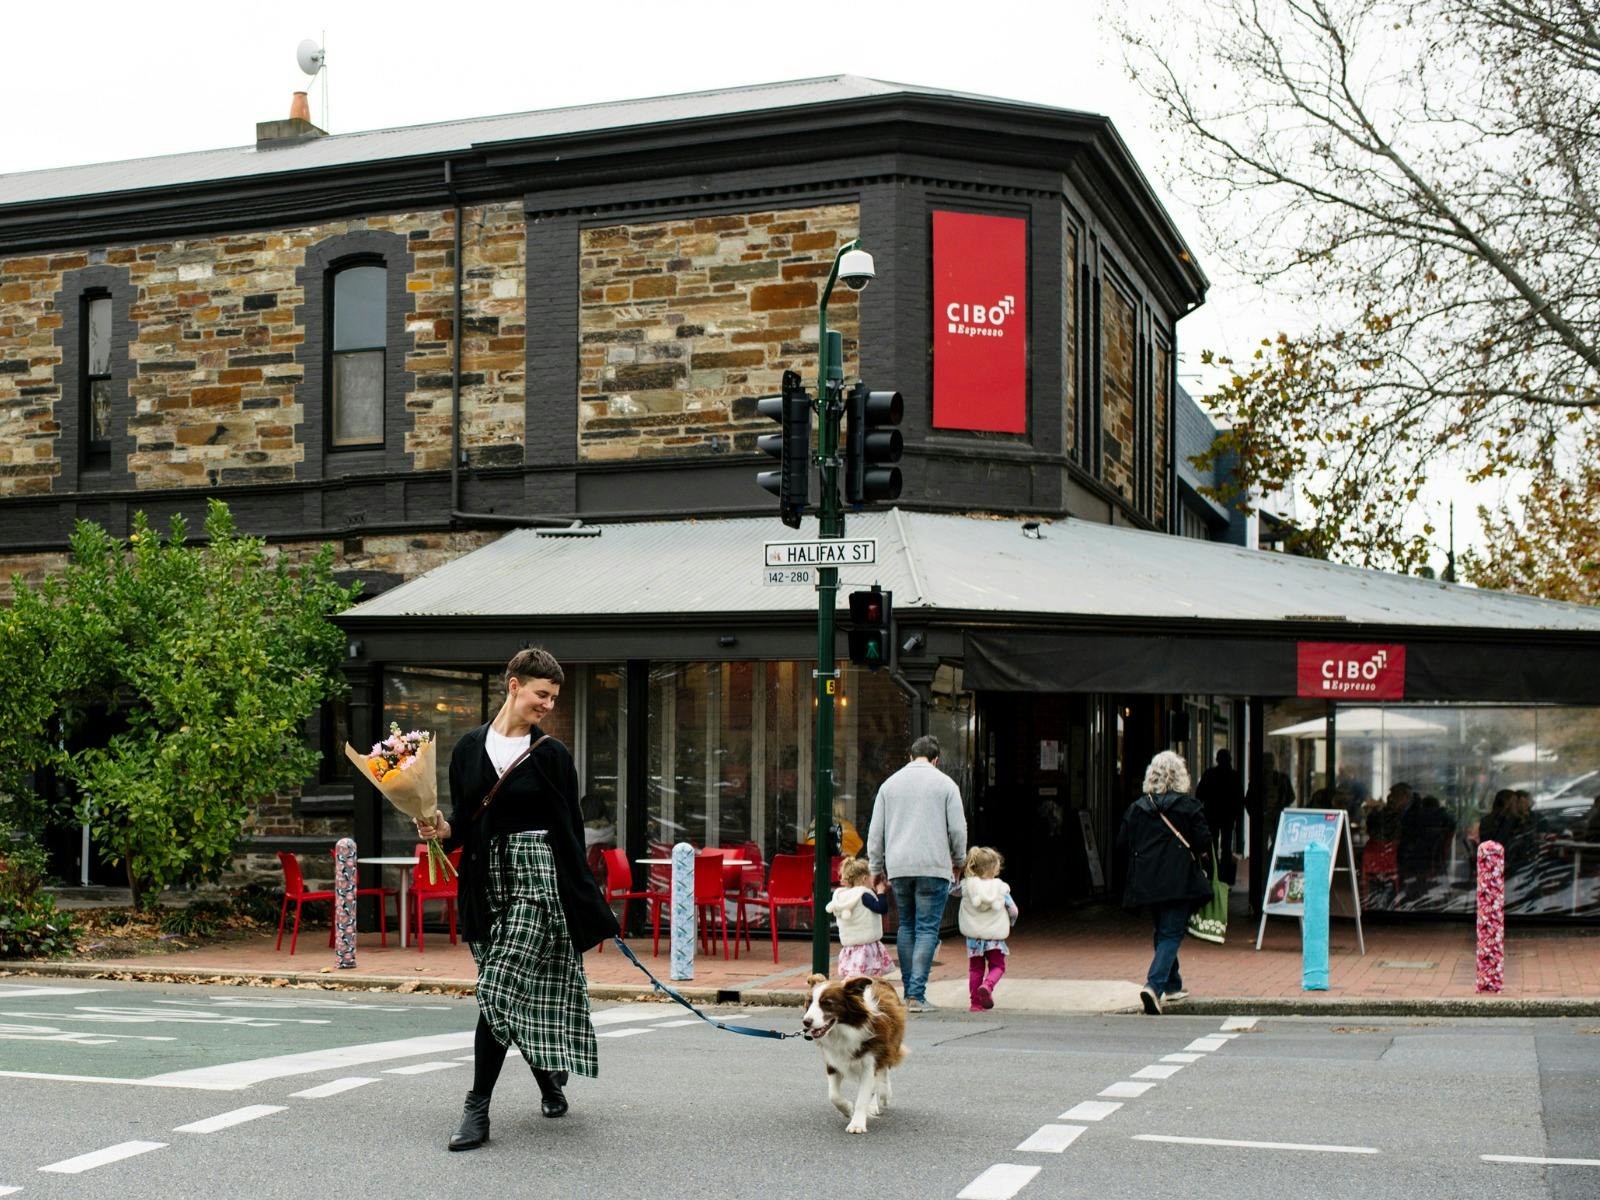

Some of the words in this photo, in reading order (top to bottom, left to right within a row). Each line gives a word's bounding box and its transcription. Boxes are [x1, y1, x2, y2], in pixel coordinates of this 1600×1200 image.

[946, 302, 1005, 326] CIBO
[957, 323, 1004, 338] Espresso
[787, 545, 846, 562] HALIFAX
[852, 544, 870, 561] ST
[768, 571, 809, 583] 142-280
[1321, 659, 1378, 680] CIBO
[1331, 679, 1377, 693] Espresso
